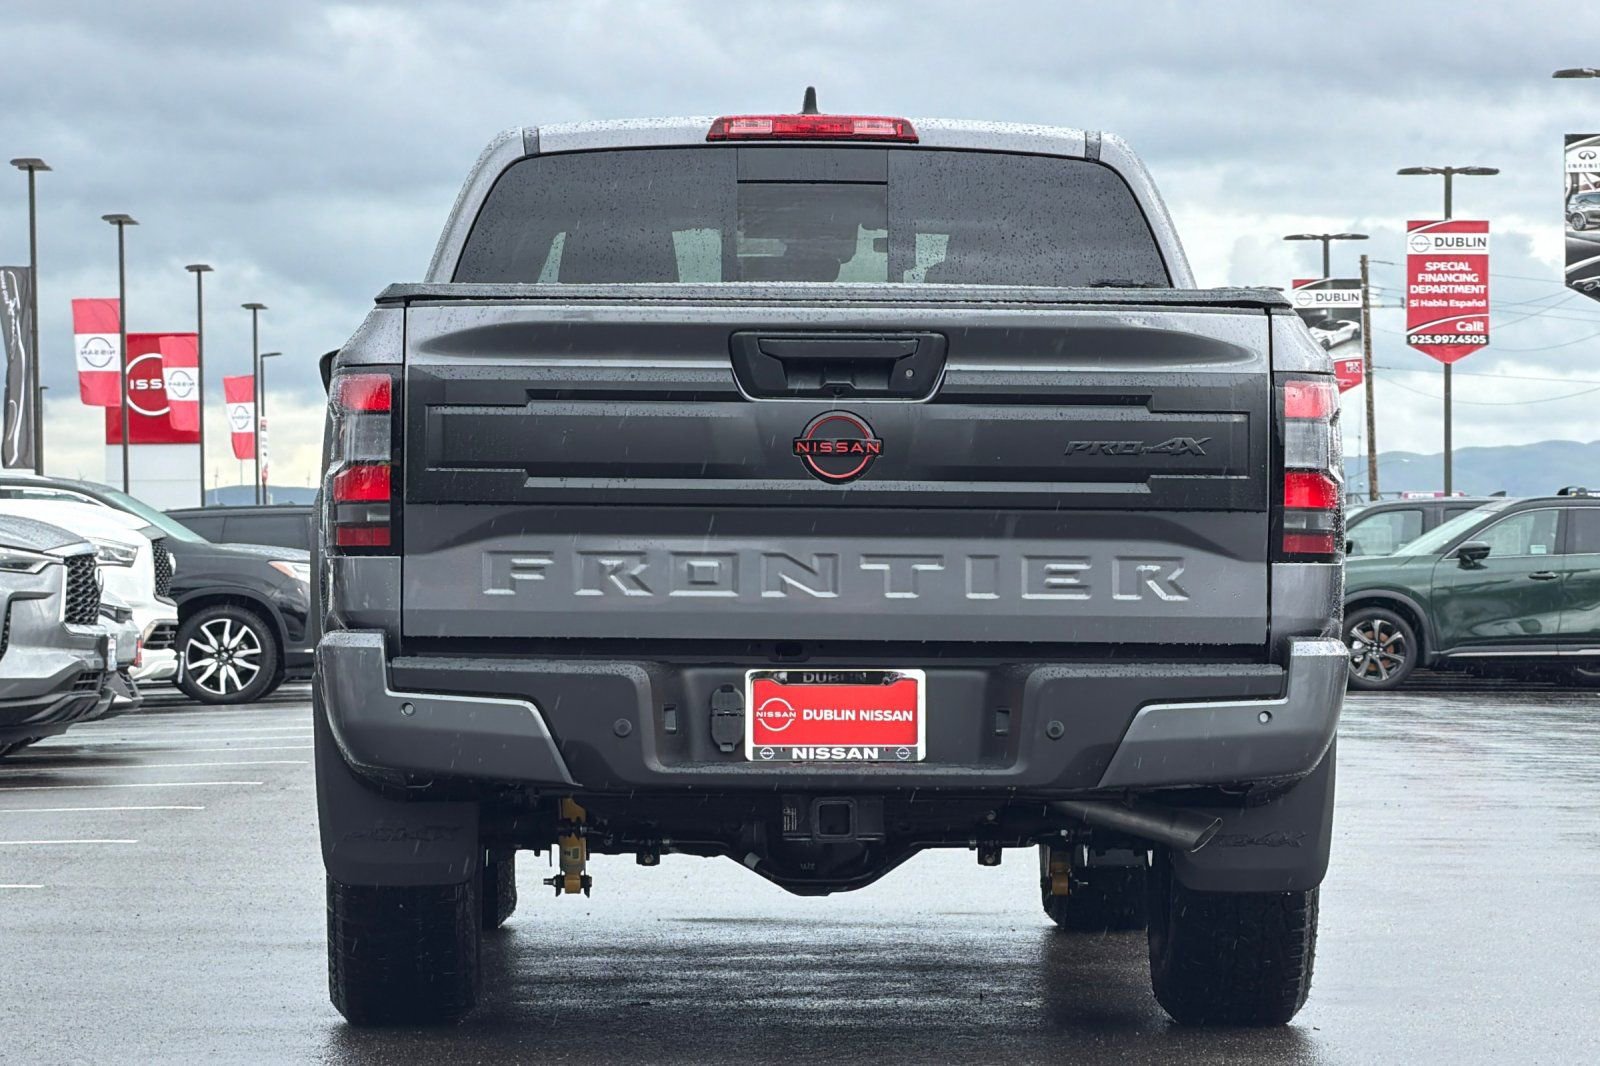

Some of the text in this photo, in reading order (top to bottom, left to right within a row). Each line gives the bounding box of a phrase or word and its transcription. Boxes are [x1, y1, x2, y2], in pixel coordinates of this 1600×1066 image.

[1435, 237, 1486, 247] DUBLIN
[1425, 262, 1472, 271] SPECIAL
[1417, 273, 1479, 282] FINANCING
[1410, 285, 1486, 294] DEPARTMENT
[1315, 293, 1360, 302] DUBLIN
[1420, 299, 1448, 307] Habla
[1449, 299, 1487, 308] Español
[1456, 321, 1484, 332] Call!
[1410, 335, 1487, 344] 925.997.4505
[796, 441, 880, 453] NISSAN
[482, 550, 1190, 601] FRONTIER
[803, 709, 913, 721] DUBLIN NISSAN
[792, 747, 879, 759] NISSAN
